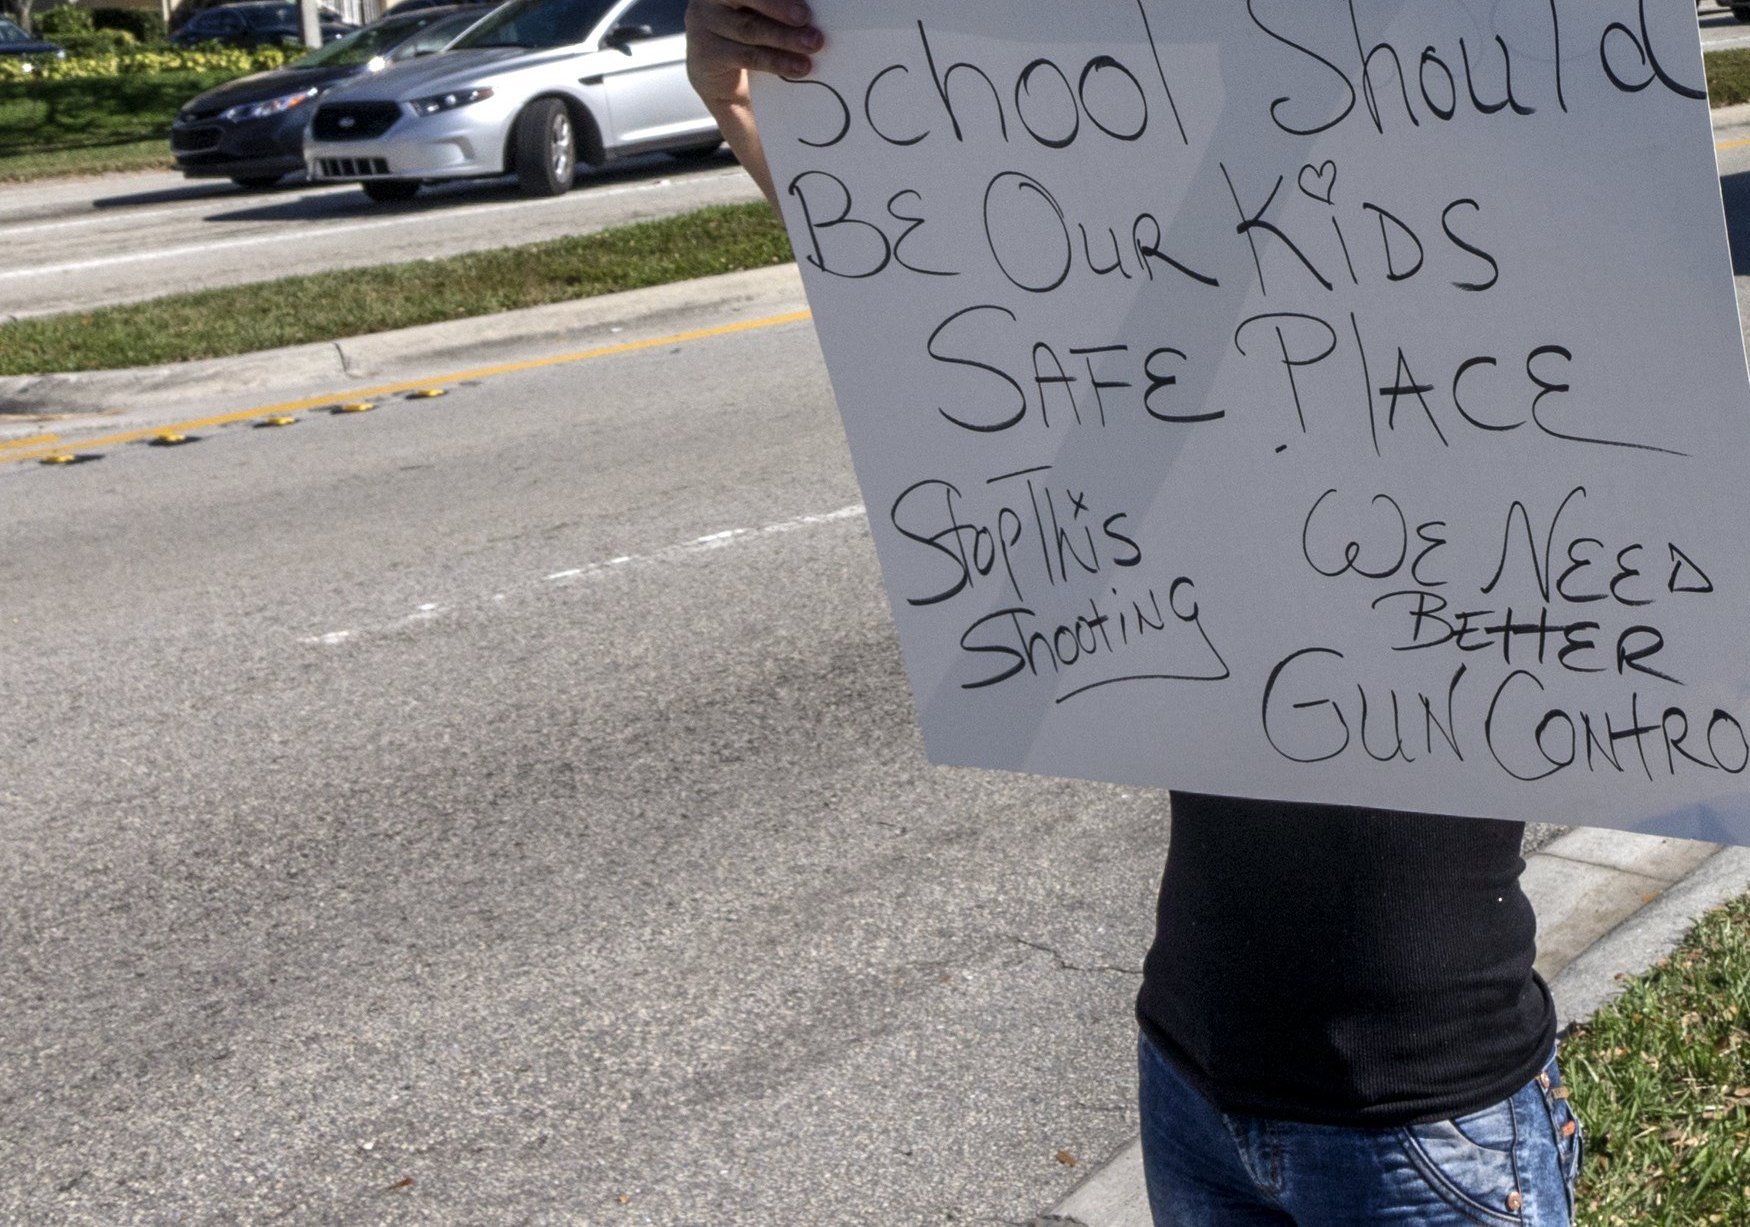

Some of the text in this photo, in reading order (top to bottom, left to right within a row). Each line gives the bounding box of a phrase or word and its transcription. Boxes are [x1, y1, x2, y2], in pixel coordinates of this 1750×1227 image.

[788, 170, 961, 278] BE
[926, 304, 1225, 432] SAFE
[1302, 485, 1715, 605] WE NEED
[1261, 646, 1467, 763] GUN
